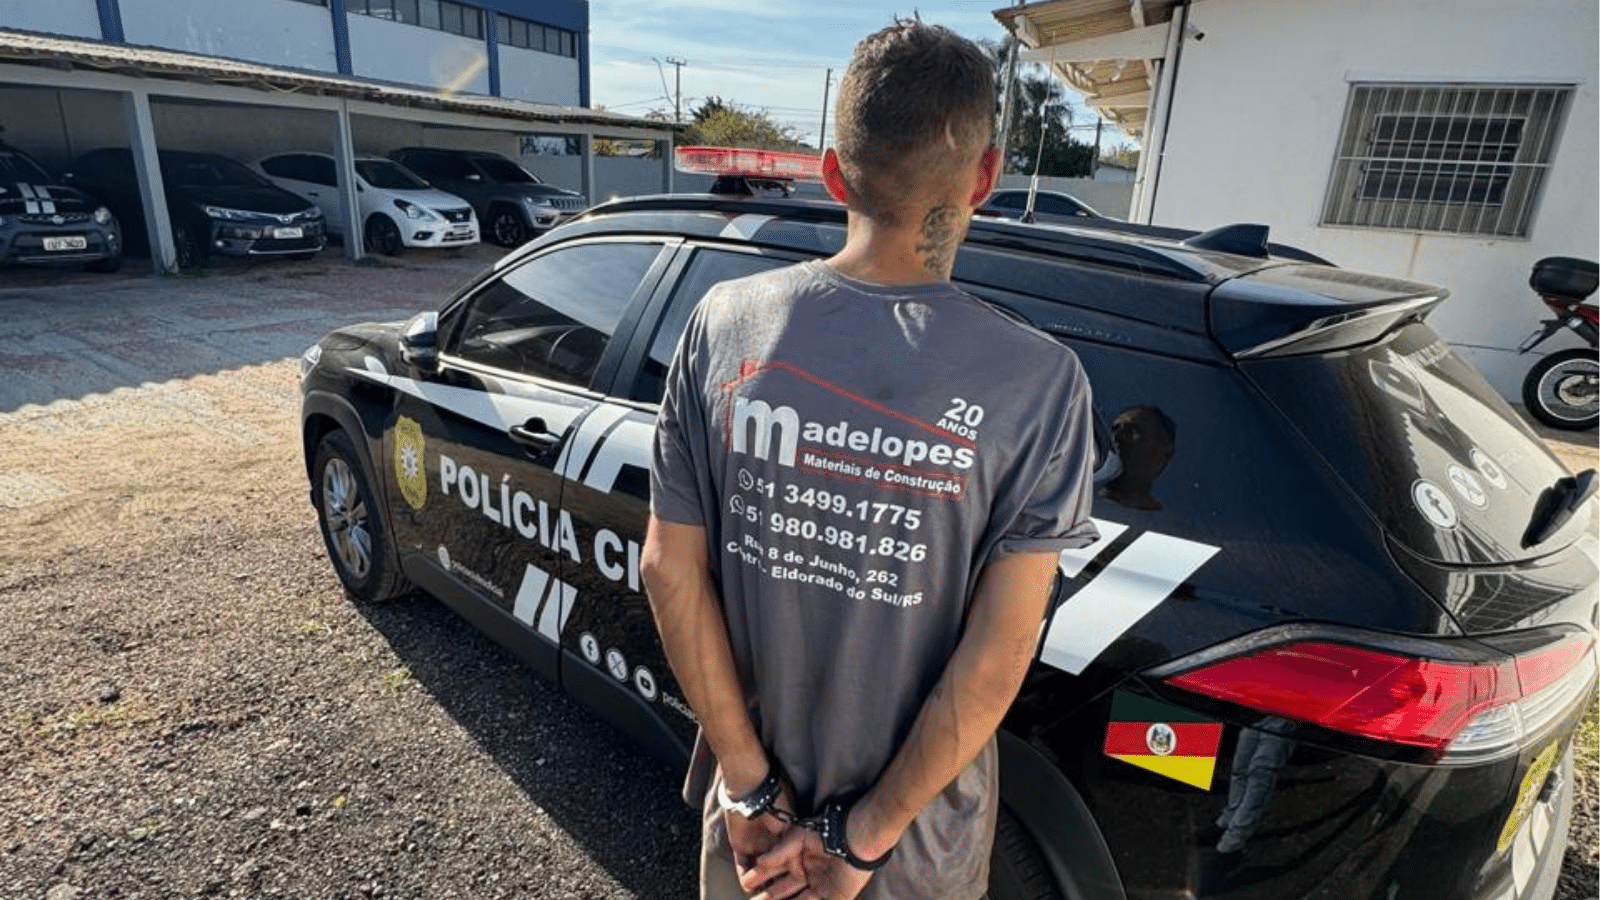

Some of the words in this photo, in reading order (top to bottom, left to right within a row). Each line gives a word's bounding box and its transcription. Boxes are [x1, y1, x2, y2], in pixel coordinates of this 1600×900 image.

[935, 417, 979, 441] ANOS
[943, 397, 985, 428] 20
[803, 453, 862, 478] Materiais
[864, 467, 881, 481] de
[883, 468, 962, 495] Construção
[439, 453, 582, 564] POLÍCIA
[755, 477, 776, 499] 51
[783, 483, 923, 531] 3499.1775
[769, 512, 928, 563] 980.981.826
[771, 565, 844, 593] Eldorado
[846, 583, 866, 601] do
[870, 585, 924, 608] Sul/RS
[783, 550, 804, 565] de
[809, 554, 861, 584] Junho,
[866, 568, 899, 588] 262
